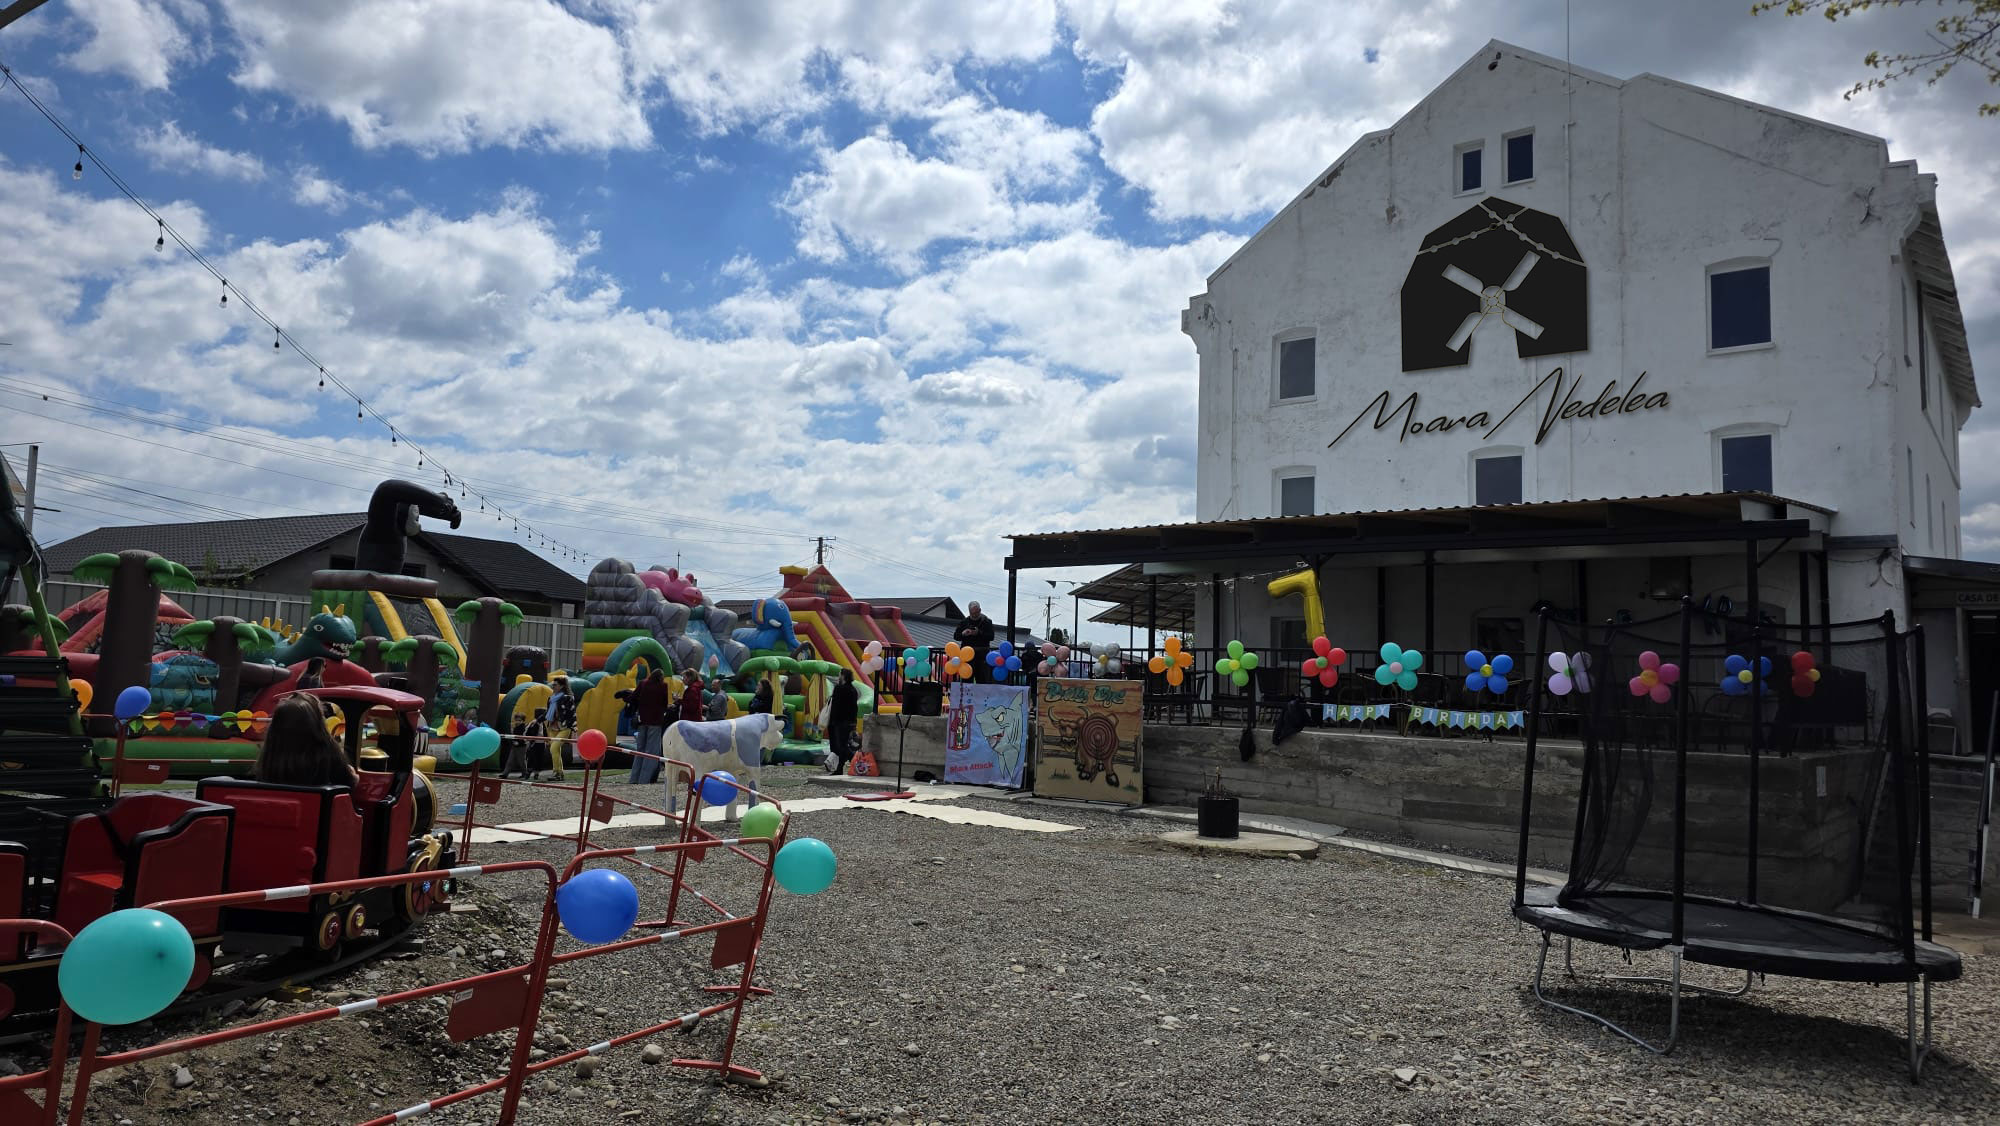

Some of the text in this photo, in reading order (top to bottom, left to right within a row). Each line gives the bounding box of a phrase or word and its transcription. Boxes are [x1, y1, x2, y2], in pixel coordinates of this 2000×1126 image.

[1327, 366, 1670, 449] Moara Nedelea
[1958, 593, 1984, 603] CASA
[1325, 705, 1519, 726] HAPPY BIRTHDAY
